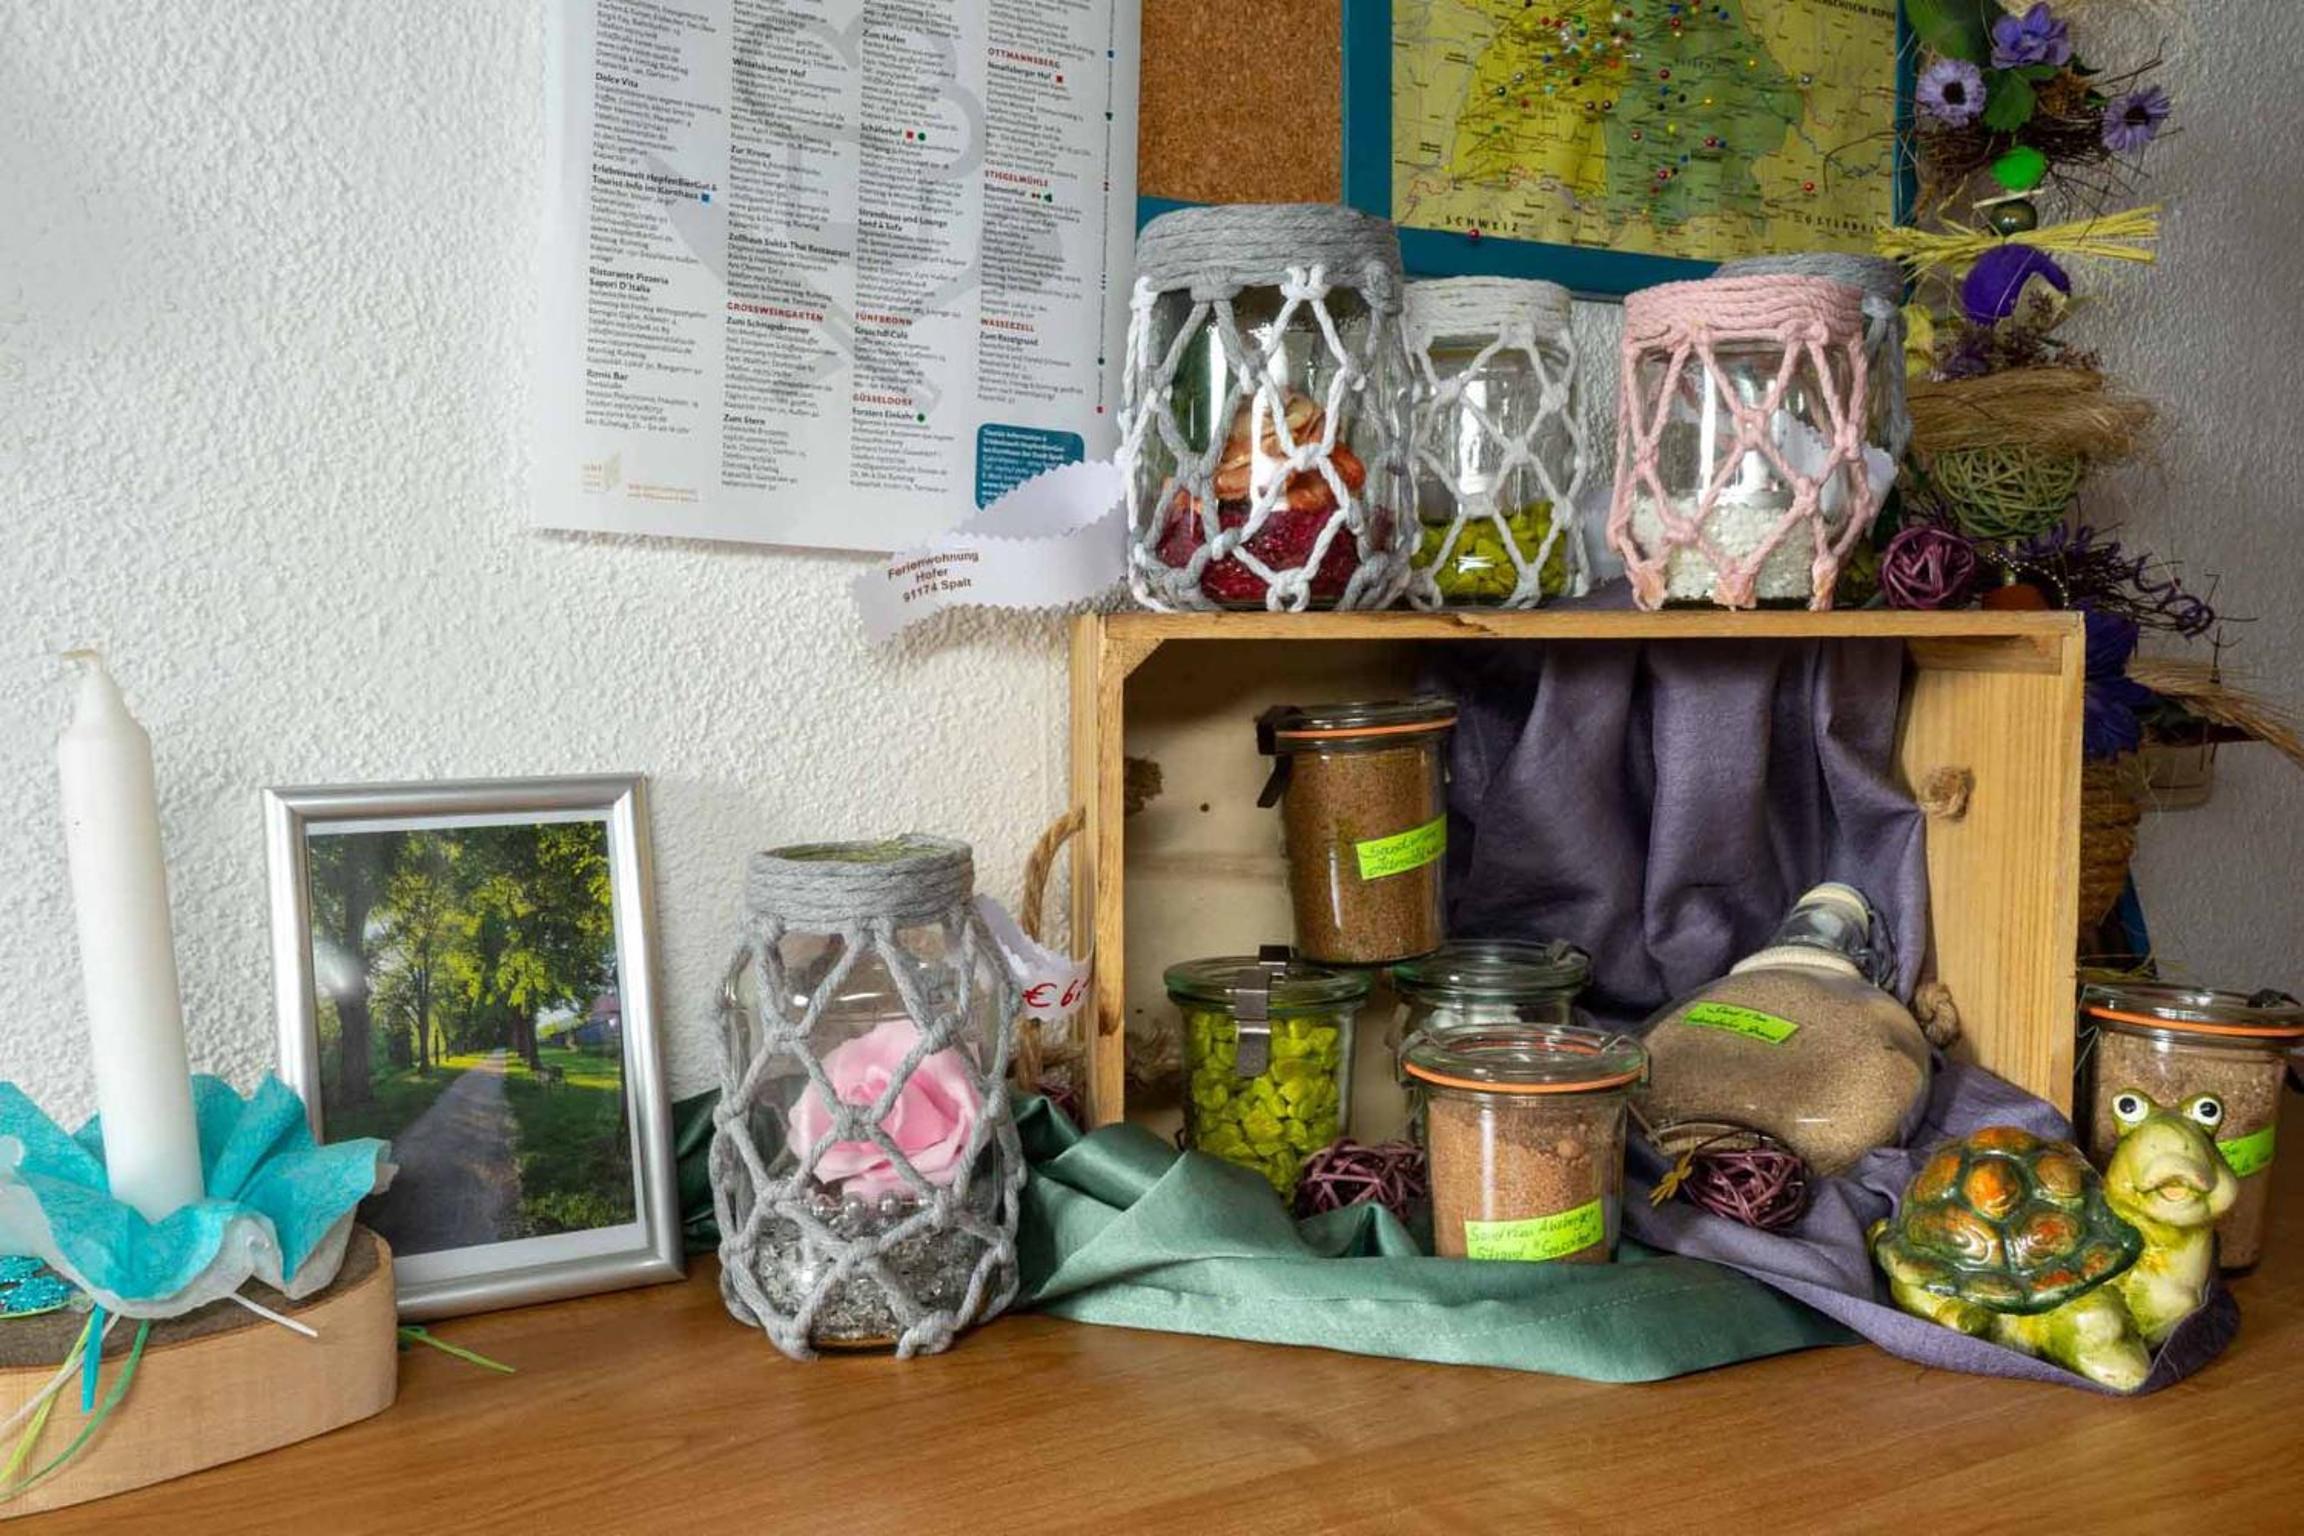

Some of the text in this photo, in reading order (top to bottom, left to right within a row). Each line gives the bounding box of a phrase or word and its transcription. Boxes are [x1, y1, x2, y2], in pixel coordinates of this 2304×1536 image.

[987, 46, 1062, 70] OTTMANNSBERG
[595, 71, 639, 89] Dolce Vita
[790, 67, 807, 79] Hof
[1445, 214, 1520, 233] SCHWEIZ
[726, 301, 824, 323] GROSSWEINGARTEN
[854, 310, 913, 326] FÜNFBRONN
[726, 315, 746, 327] Zum
[980, 317, 1036, 334] WASSERZELL
[613, 370, 629, 380] Bar
[852, 391, 914, 406] GÜSSELDORF
[722, 412, 742, 423] Zum
[887, 552, 980, 581] Ferienwohnung
[915, 567, 949, 584] Hofer
[902, 578, 972, 603] 91174 Spalt
